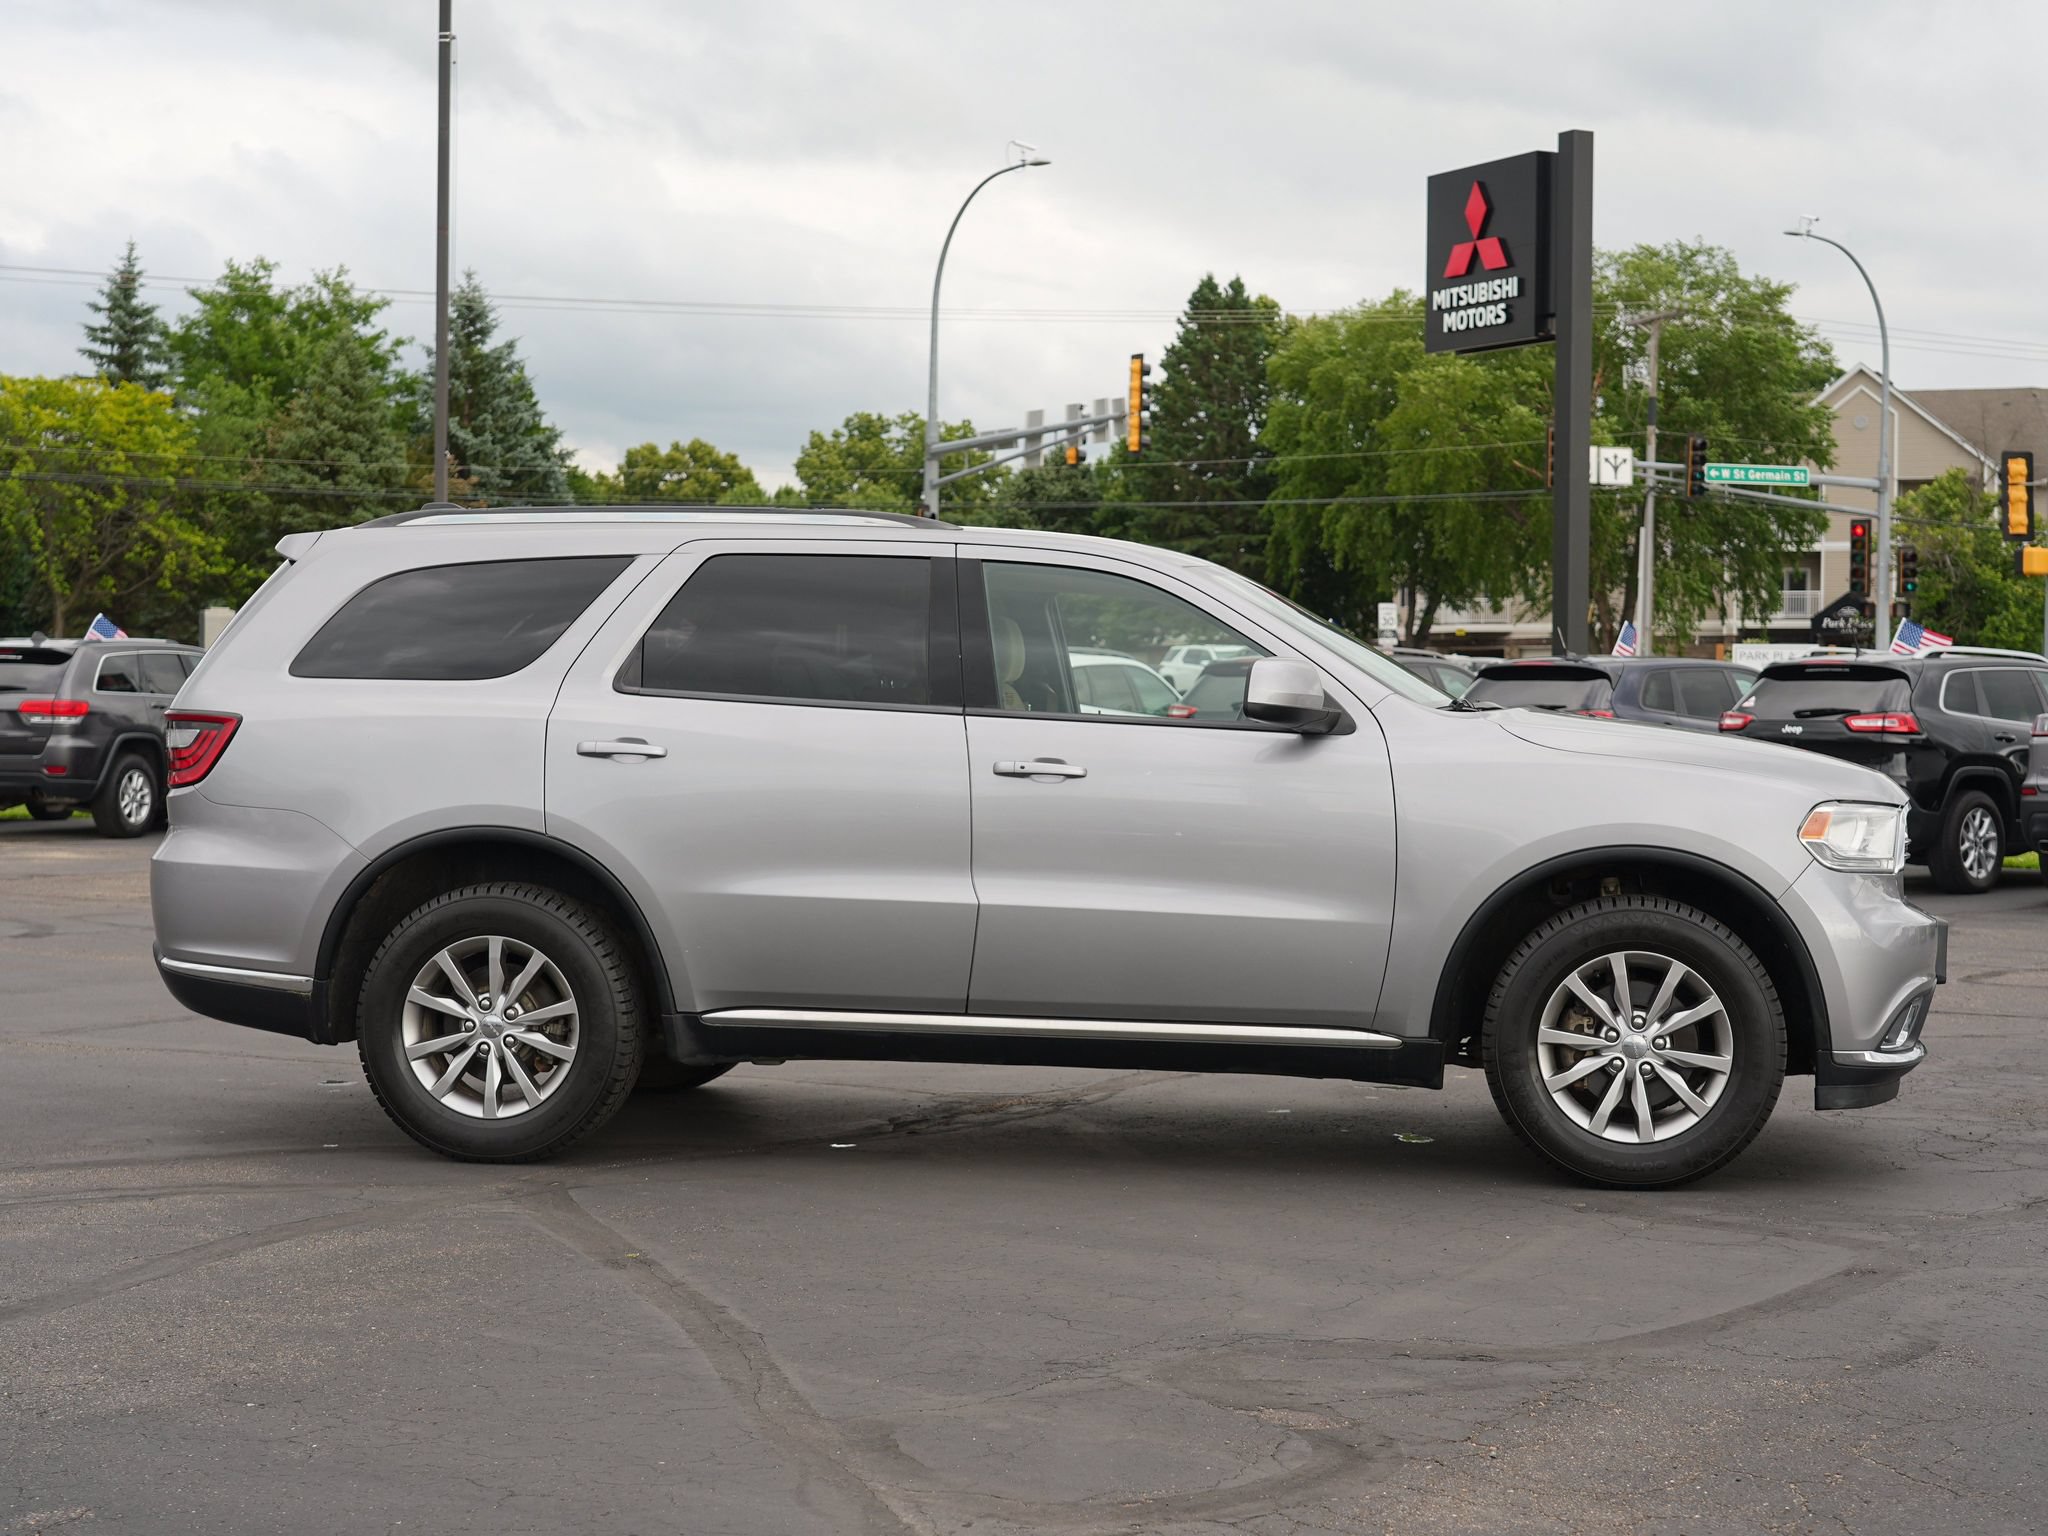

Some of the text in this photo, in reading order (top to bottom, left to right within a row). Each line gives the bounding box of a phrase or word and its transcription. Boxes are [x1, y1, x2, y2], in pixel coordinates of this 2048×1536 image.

[1431, 276, 1519, 311] MITSUBISHI
[1442, 302, 1507, 333] MOTORS
[1721, 468, 1806, 482] W St Germain St
[1822, 616, 1845, 629] Park
[1739, 650, 1770, 661] PARK
[1781, 723, 1803, 736] Jeep
